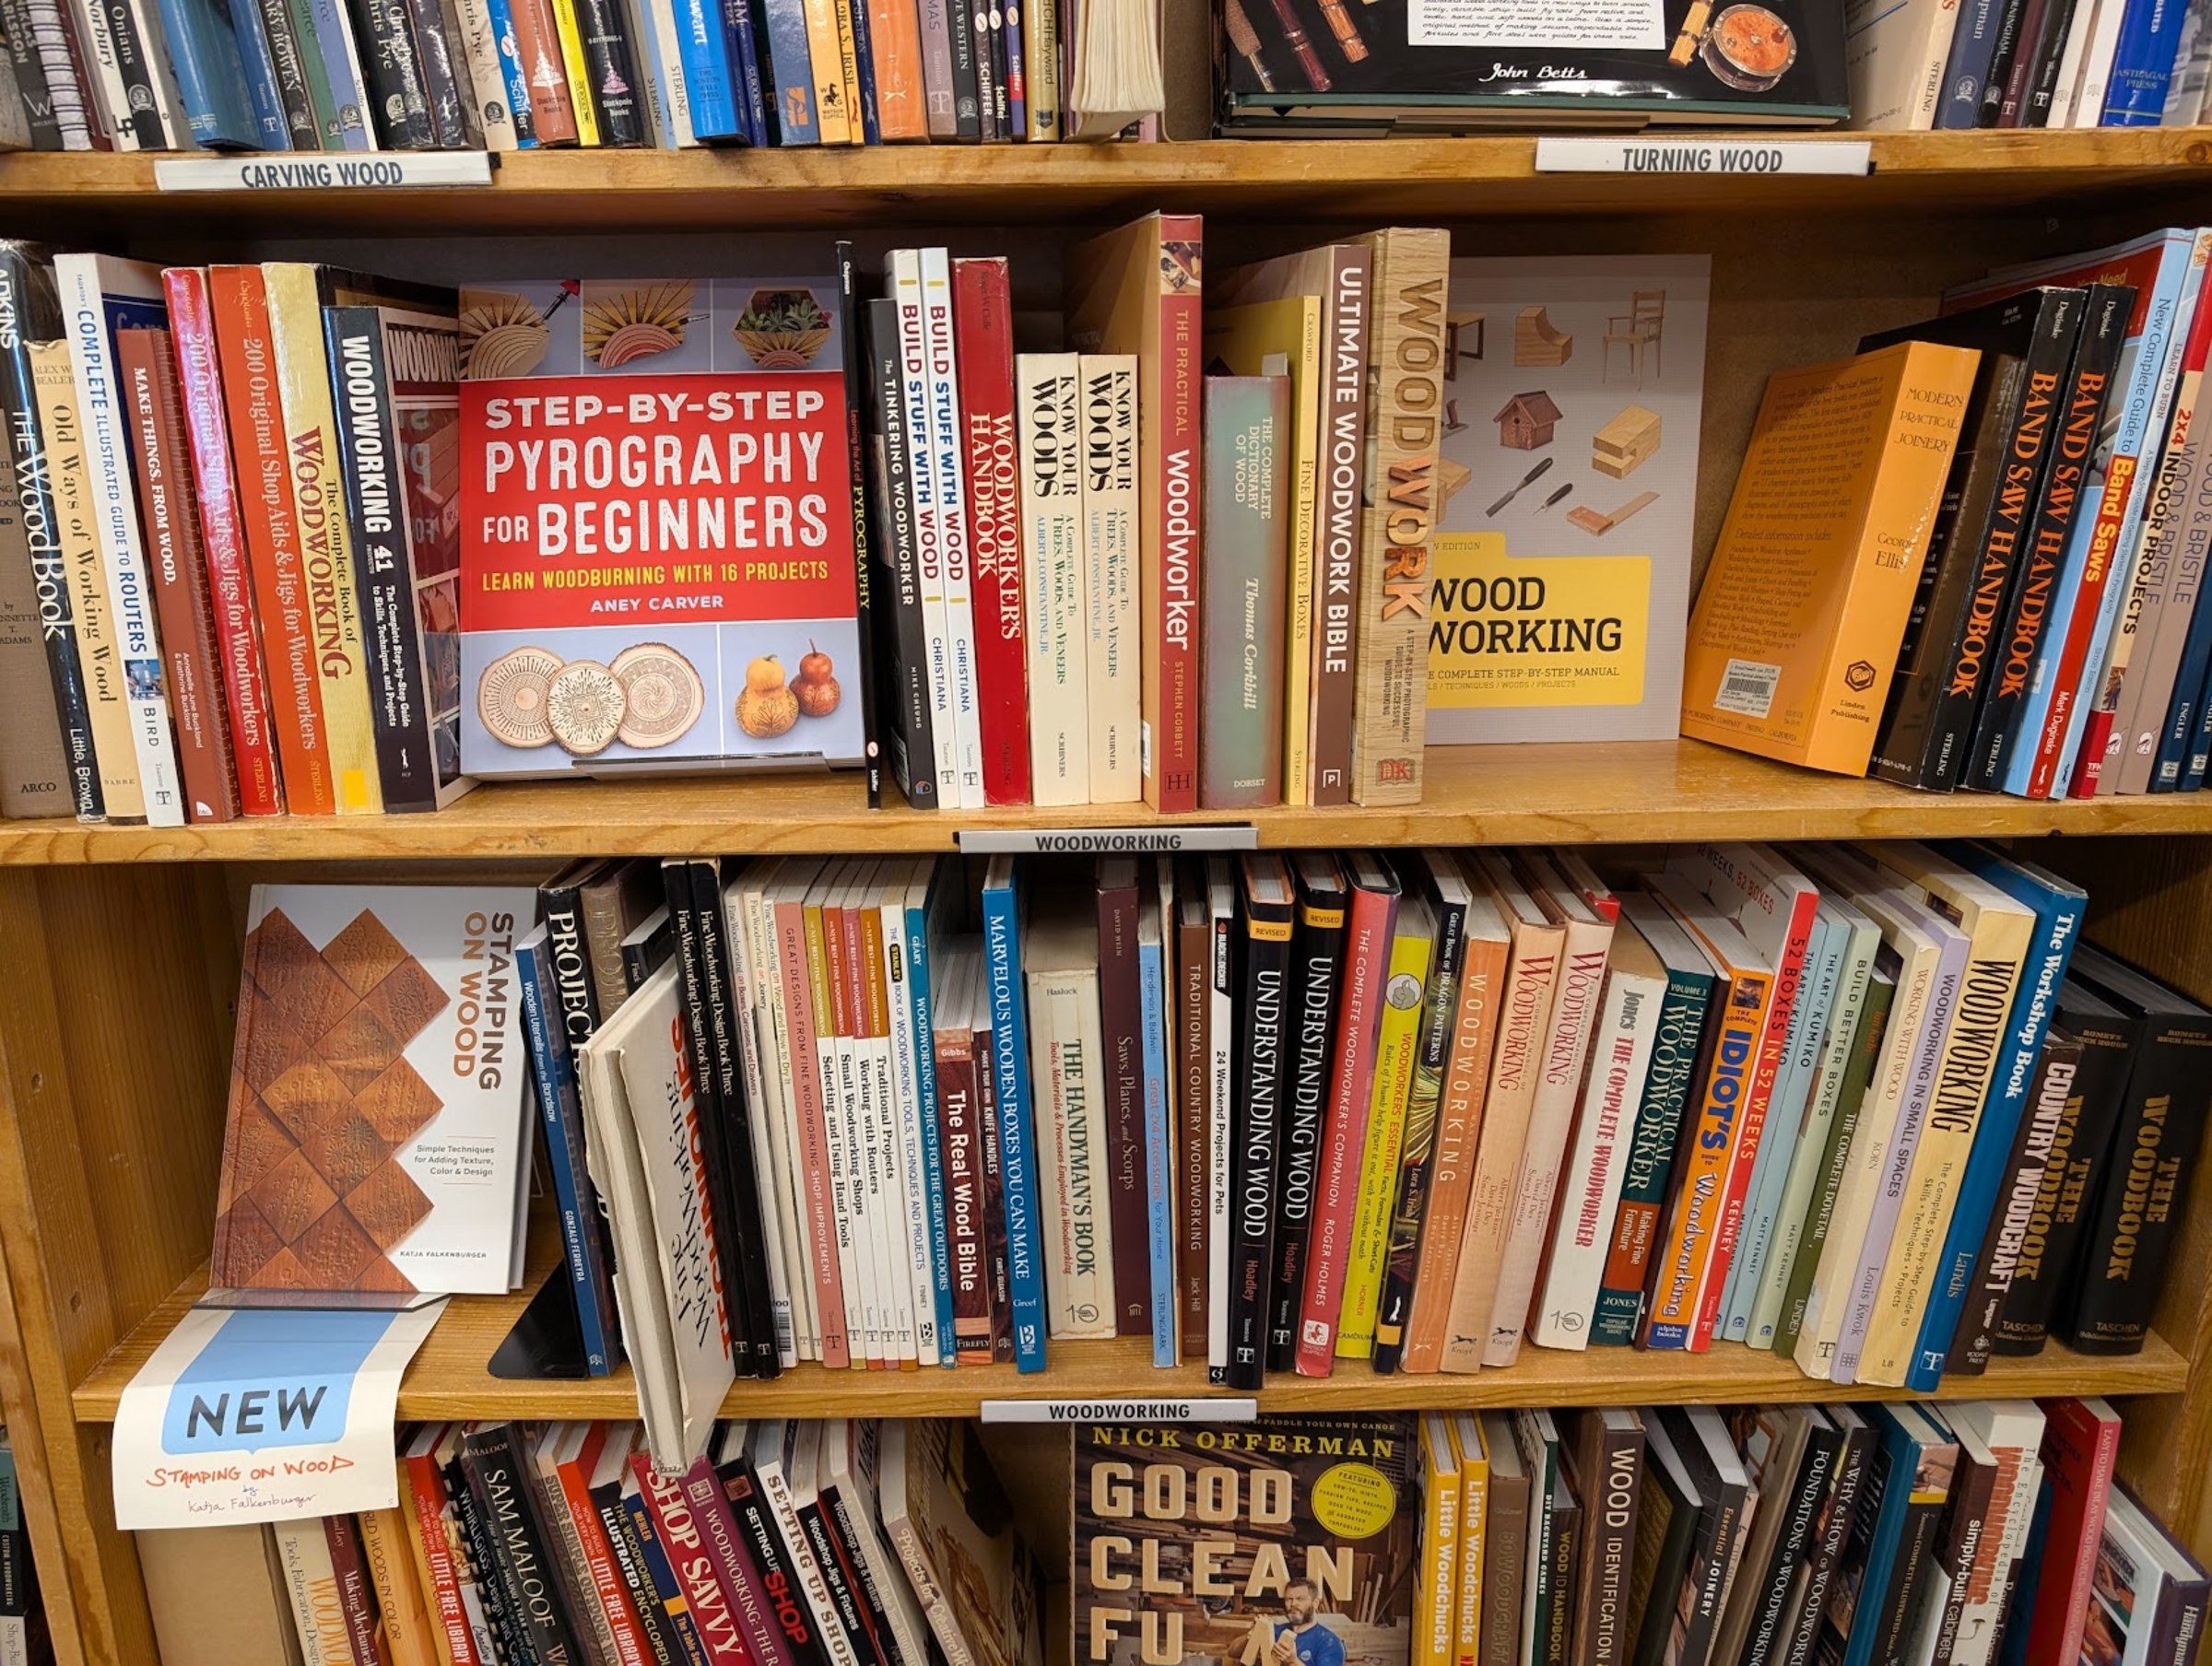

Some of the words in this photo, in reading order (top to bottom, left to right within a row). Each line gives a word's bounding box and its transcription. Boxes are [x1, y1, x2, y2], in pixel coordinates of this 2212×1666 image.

[979, 61, 993, 116] SCHIFFER
[1478, 63, 1527, 82] John
[1537, 65, 1588, 79] Betts
[1922, 60, 1941, 112] STERLING
[241, 164, 332, 187] CARVING
[336, 162, 403, 185] WOOD
[1623, 148, 1714, 173] TURNING
[1720, 148, 1783, 172] WOOD
[901, 305, 922, 374] BUILD
[1176, 311, 1189, 342] THE
[1336, 267, 1362, 403] ULTIMATE
[77, 311, 108, 408] COMPLETE
[134, 367, 152, 414] MAKE
[485, 390, 825, 429] STEP-BY-STEP
[908, 381, 927, 444] STUFF
[1115, 370, 1132, 428] KNOW
[1176, 347, 1190, 436] PRACTICAL
[2062, 370, 2105, 459] BAND
[11, 408, 37, 453] THE
[53, 405, 76, 443] Old
[342, 335, 393, 534] WOODWORKING
[1088, 372, 1113, 492] WOODS
[1236, 434, 1246, 453] OF
[1262, 416, 1273, 440] THE
[2171, 410, 2192, 446] 2x4
[58, 454, 80, 510] Ways
[96, 414, 120, 500] ILLUSTRATED
[485, 430, 825, 493] PYROGRAPHY
[913, 450, 932, 504] WITH
[1116, 434, 1132, 490] YOUR
[1235, 457, 1246, 502] WOOD
[1248, 426, 1260, 510] DICTIONARY
[1261, 443, 1273, 519] COMPLETE
[151, 484, 167, 530] FROM
[884, 379, 901, 475] TINKERING
[895, 481, 914, 605] WOODWORKER
[971, 412, 998, 580] HANDBOOK
[1328, 412, 1358, 596] WOODWORK
[2045, 464, 2082, 524] SAW
[2101, 458, 2135, 516] Band
[2149, 450, 2182, 530] INDOOR
[70, 520, 92, 543] of
[111, 506, 127, 545] GUIDE
[290, 425, 352, 680] WOODWORKING
[482, 515, 529, 543] FOR
[537, 493, 829, 557] BEGINNERS
[920, 510, 939, 580] WOOD
[991, 412, 1021, 639] WOODWORKER'S
[2085, 521, 2117, 583] Saws
[117, 551, 130, 566] TO
[157, 531, 176, 586] WOOD.
[482, 571, 535, 592] LEARN
[541, 565, 665, 590] WOODBURNING
[673, 563, 713, 582] WITH
[720, 563, 737, 581] 16
[745, 560, 829, 581] PROJECTS
[2123, 535, 2159, 635] PROJECTS
[76, 548, 101, 639] Working
[119, 572, 147, 653] ROUTERS
[590, 597, 641, 613] ANEY
[648, 595, 724, 611] CARVER
[1430, 577, 1546, 613] WOOD
[1998, 529, 2063, 699] HANDBOOK
[1325, 604, 1349, 673] BIBLE
[1429, 617, 1622, 655] WORKING
[90, 645, 117, 702] Wood
[932, 637, 947, 711] CHRISTIANA
[1173, 661, 1184, 709] STEPHEN
[1438, 669, 1494, 680] COMPLETE
[1497, 667, 1571, 678] STEP-BY-STEP
[1574, 666, 1620, 676] MANUAL
[143, 708, 159, 747] BIRD
[1173, 710, 1183, 759] CORBETT
[20, 782, 56, 793] ARCO
[1035, 834, 1182, 851] WOODWORKING
[462, 911, 488, 960] ON
[1359, 929, 1371, 953] THE
[1790, 938, 1806, 958] 52
[2050, 912, 2076, 950] The
[990, 915, 1011, 1021] MARVELOUS
[1349, 956, 1367, 1023] COMPLETE
[453, 971, 482, 1077] WOOD
[479, 912, 514, 1091] STAMPING
[1190, 964, 1201, 1060] TRADITIONAL
[1548, 950, 1606, 1086] WOODWORKING
[1771, 968, 1797, 1032] BOXES
[2018, 954, 2064, 1046] Workshop
[841, 1054, 853, 1090] Small
[998, 1024, 1017, 1098] WOODEN
[1063, 1038, 1083, 1081] THE
[1248, 970, 1282, 1162] UNDERSTANDING
[1617, 1037, 1634, 1065] THE
[1763, 1039, 1781, 1061] IN
[1930, 959, 2018, 1134] WOODWORKING
[2006, 1050, 2033, 1099] Book
[1190, 1065, 1202, 1132] COUNTRY
[1337, 1026, 1359, 1129] WOODWORKER'S
[1439, 974, 1488, 1181] WOODWORKING
[1595, 1069, 1629, 1141] COMPLETE
[1701, 1029, 1753, 1150] IDIOT'S
[1757, 1069, 1773, 1088] 52
[843, 1093, 861, 1176] Woodworking
[947, 1090, 966, 1128] The
[1004, 1101, 1021, 1157] BOXES
[1740, 1095, 1768, 1160] WEEKS
[2025, 1062, 2077, 1163] COUNTRY
[414, 1156, 427, 1165] for
[428, 1156, 458, 1167] Adding
[460, 1156, 494, 1167] Texture,
[417, 1144, 444, 1156] Simple
[447, 1144, 495, 1156] Techniques
[430, 1167, 453, 1176] Color
[454, 1167, 462, 1176] &
[464, 1167, 494, 1178] Design
[950, 1133, 971, 1179] Real
[1008, 1158, 1022, 1191] YOU
[1066, 1084, 1092, 1215] HANDYMAN'S
[1329, 1133, 1346, 1208] COMPANION
[853, 1179, 864, 1215] Shops
[954, 1181, 974, 1238] Wood
[1009, 1193, 1025, 1231] CAN
[1190, 1137, 1202, 1250] WOODWORKING
[1243, 1167, 1270, 1237] WOOD
[1575, 1145, 1612, 1249] WOODWORKER
[1075, 1221, 1097, 1277] BOOK
[1323, 1219, 1335, 1258] ROGER
[1663, 1172, 1718, 1318] Woodworking
[1721, 1199, 1741, 1253] KENNEY
[1985, 1167, 2045, 1294] WOODCRAFT
[958, 1243, 977, 1292] Bible
[1013, 1232, 1030, 1279] MAKE
[1315, 1261, 1331, 1307] HOLMES
[186, 1386, 328, 1437] NEW
[1049, 1404, 1191, 1419] WOODWORKING
[1093, 1427, 1181, 1449] NICK
[1196, 1431, 1394, 1458] OFFERMAN
[146, 1468, 241, 1488] STAMPING
[251, 1466, 275, 1480] ON
[286, 1455, 355, 1474] WOOD
[1090, 1462, 1292, 1525] GOOD
[1606, 1448, 1636, 1528] WOOD
[1787, 1449, 1830, 1551] FOUNDATIONS
[187, 1499, 226, 1513] Katja
[1439, 1490, 1457, 1539] Little
[485, 1469, 519, 1522] SAM
[504, 1526, 556, 1628] MALOOF
[647, 1470, 701, 1550] SHOP
[682, 1556, 743, 1656] SAVVY
[1090, 1536, 1355, 1602] CLEAN
[1951, 1519, 1982, 1603] simply-built
[1434, 1543, 1453, 1654] Woodchucks
[1596, 1538, 1623, 1659] IDENTIFICATION
[1937, 1605, 1960, 1659] cabinets
